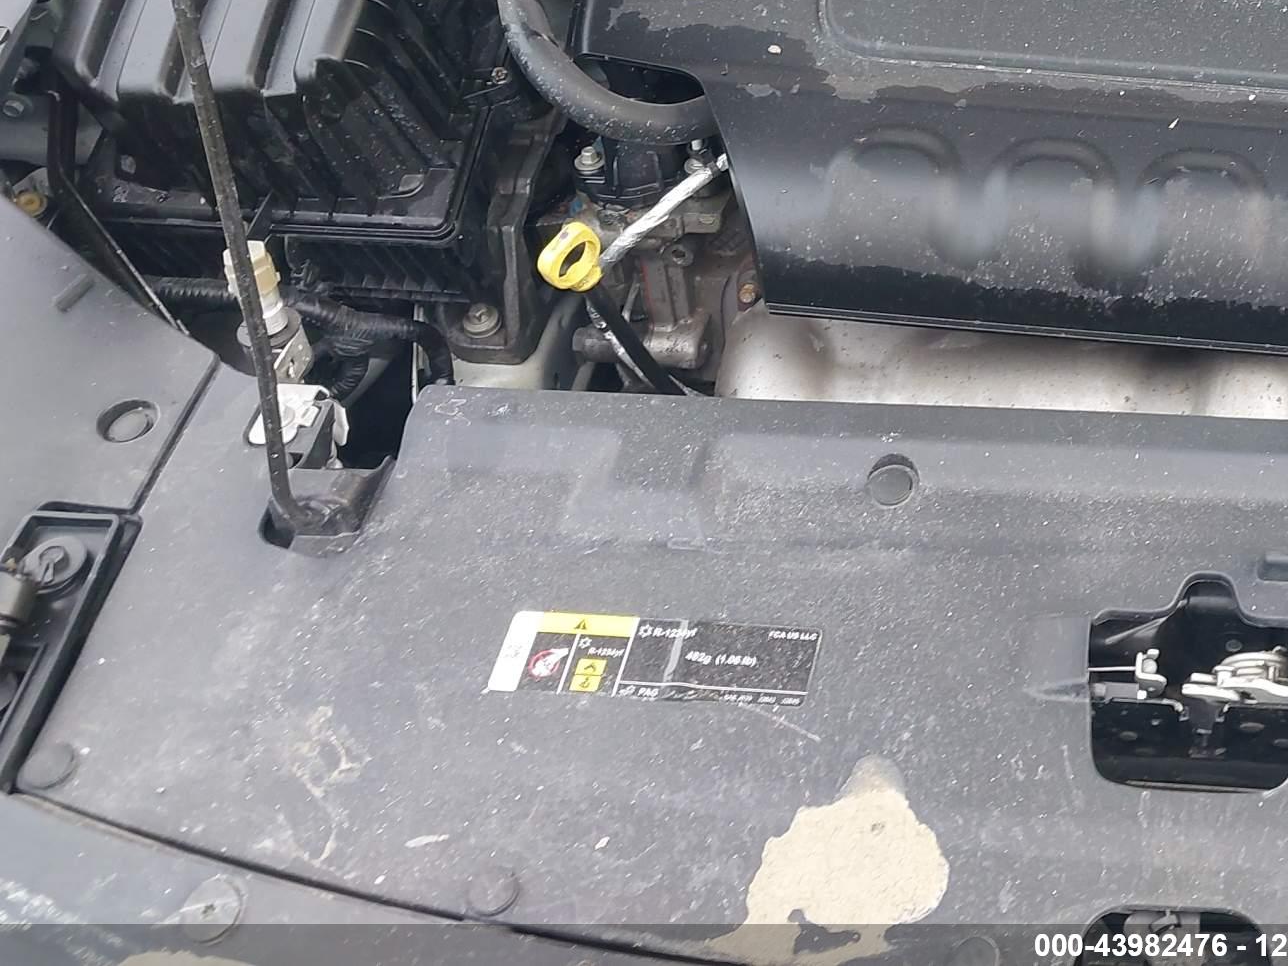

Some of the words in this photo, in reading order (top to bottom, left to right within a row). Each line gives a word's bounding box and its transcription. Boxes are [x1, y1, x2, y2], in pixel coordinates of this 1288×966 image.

[768, 631, 786, 640] FCA
[787, 631, 800, 640] US
[801, 632, 819, 641] LLC
[637, 687, 660, 698] PAG
